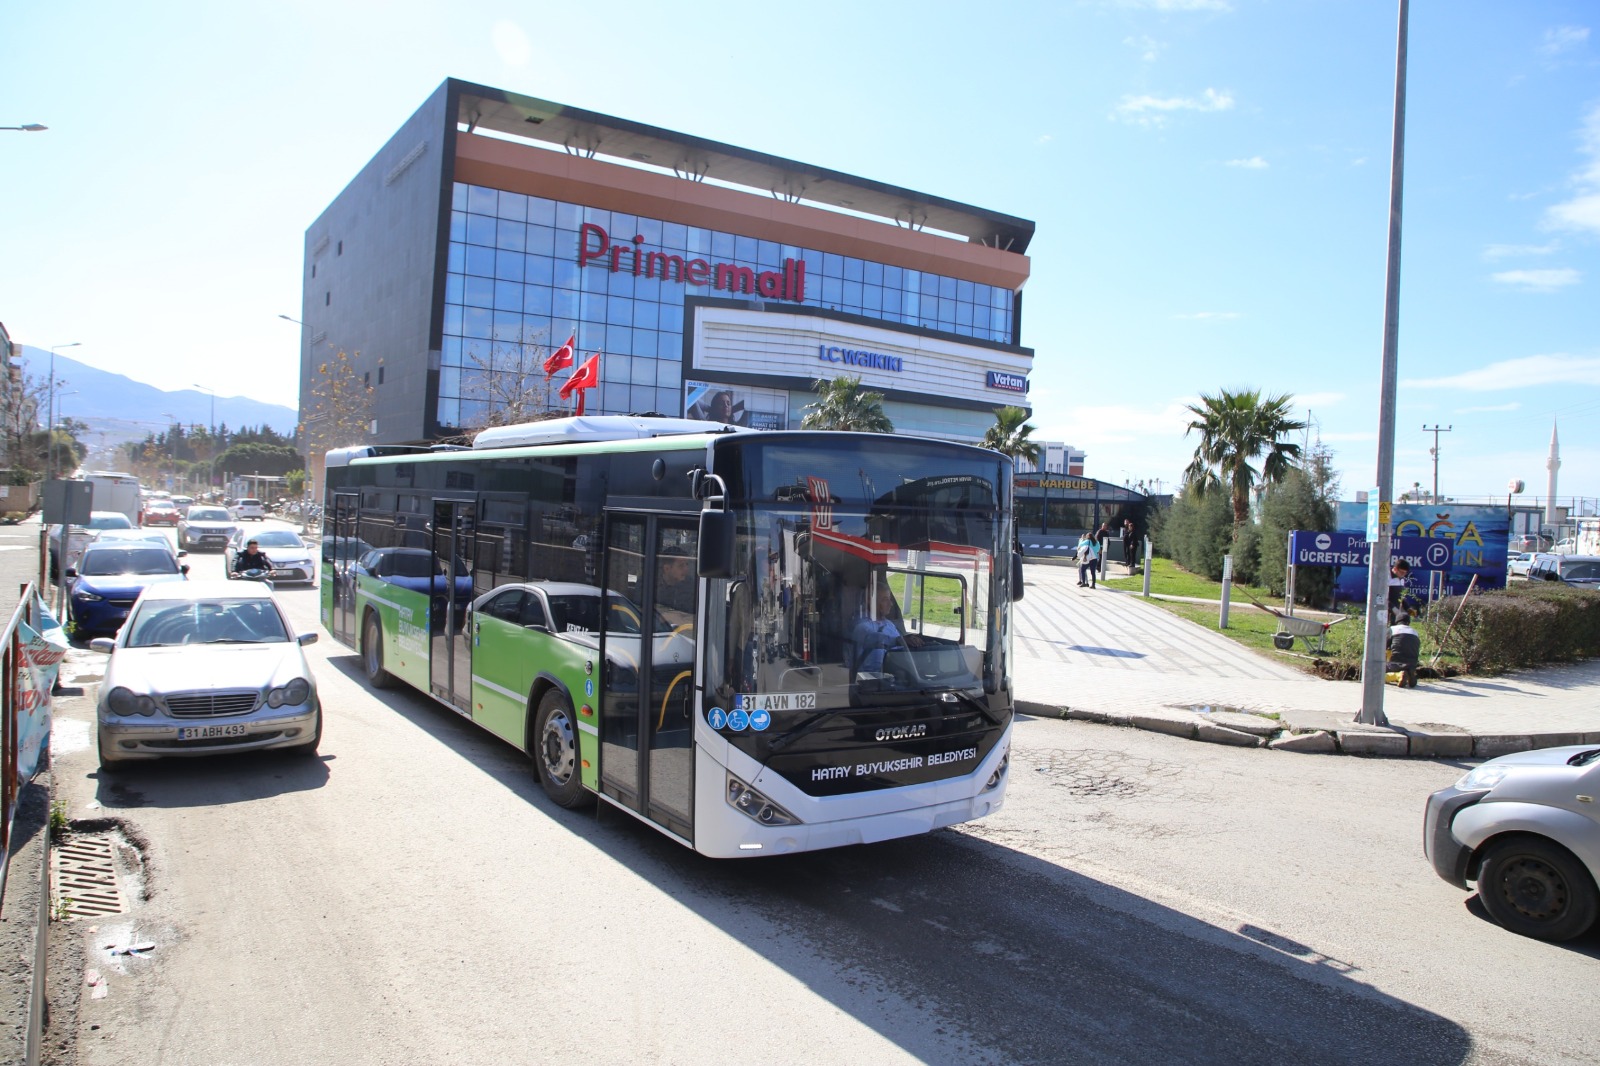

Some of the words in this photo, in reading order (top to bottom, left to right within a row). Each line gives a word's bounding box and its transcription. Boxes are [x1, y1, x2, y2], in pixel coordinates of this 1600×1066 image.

[579, 222, 806, 302] Primemall
[819, 345, 842, 363] LC
[993, 373, 1023, 388] Vatan
[1396, 513, 1485, 547] OĞA
[1348, 536, 1400, 550] Primll
[1299, 550, 1359, 565] ÜCRETSİZ
[742, 696, 756, 710] 31
[764, 695, 789, 710] AVN
[795, 694, 815, 708] 182
[186, 728, 199, 738] 31
[202, 727, 223, 737] ABH
[225, 725, 245, 735] 493
[875, 724, 927, 741] OTOKAR
[811, 765, 852, 781] HATAY
[928, 748, 976, 767] BELEDİYESİ
